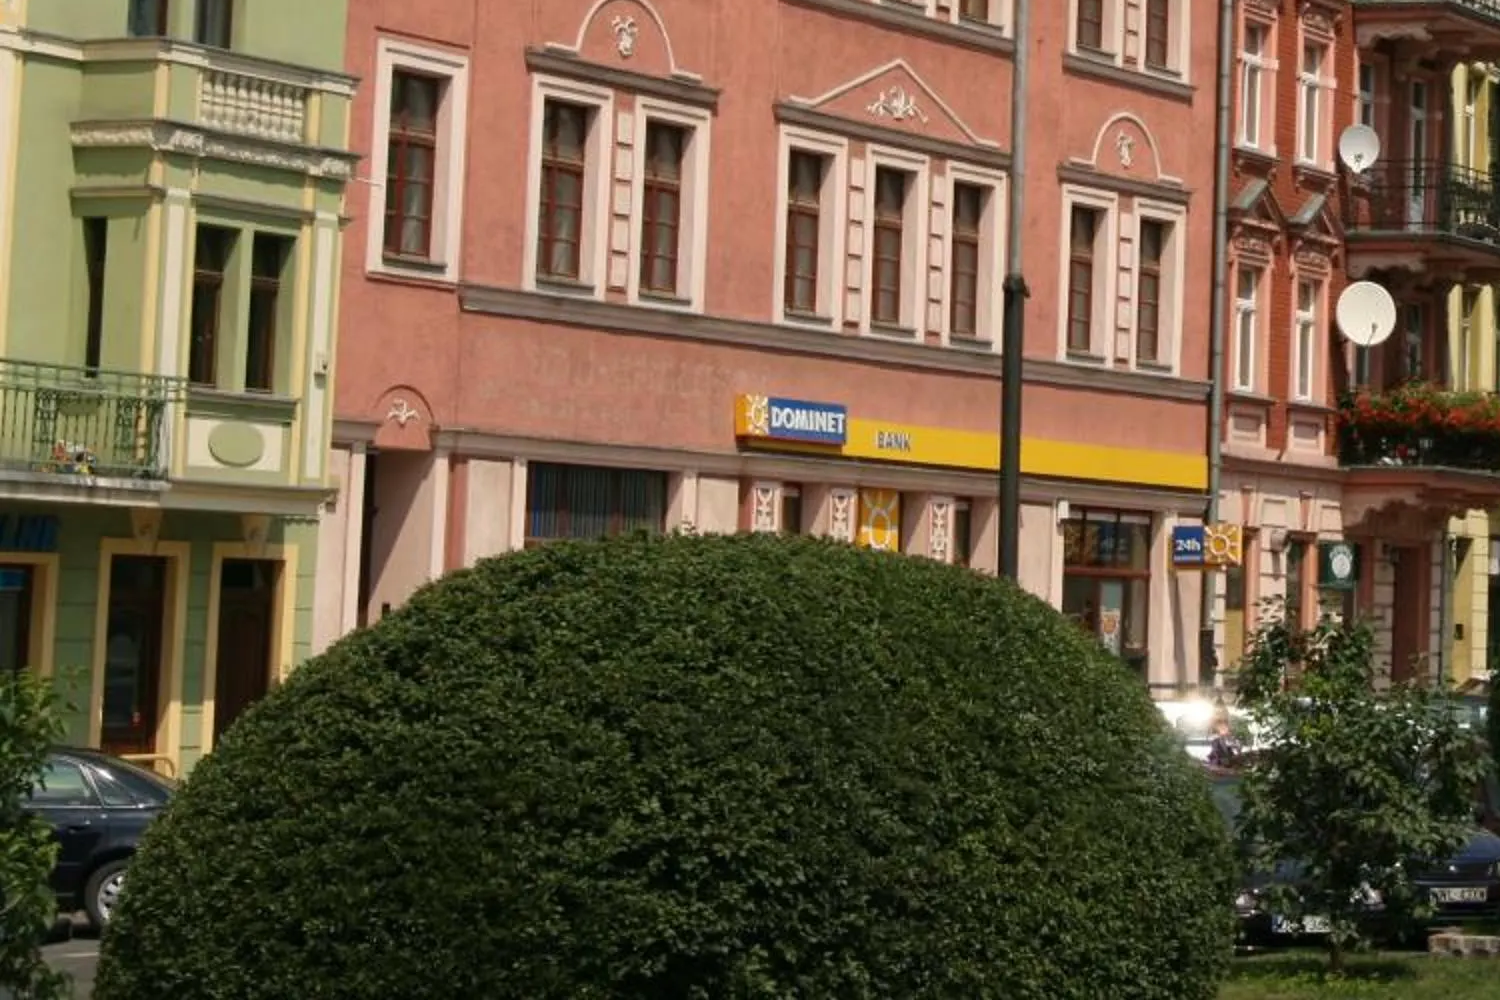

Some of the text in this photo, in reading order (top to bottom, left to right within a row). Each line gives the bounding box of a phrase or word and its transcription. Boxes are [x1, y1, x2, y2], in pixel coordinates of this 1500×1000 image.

[771, 406, 845, 434] DOMINET
[876, 430, 911, 451] BANK
[1176, 538, 1201, 551] 24h
